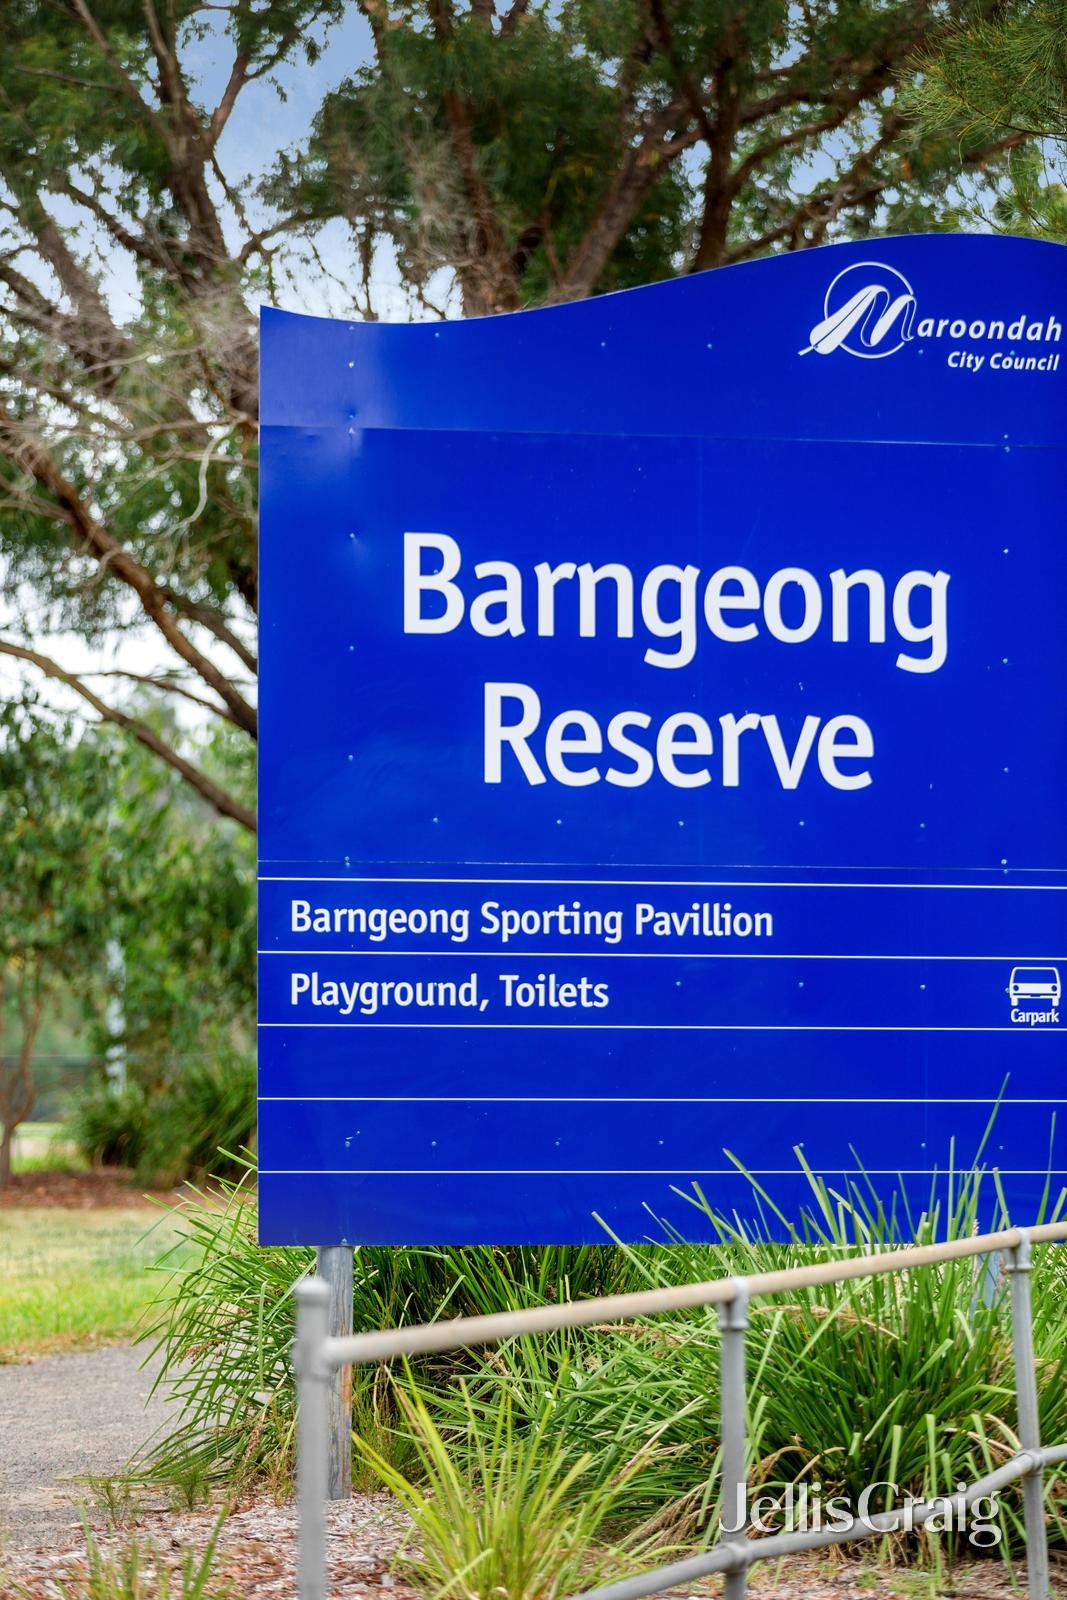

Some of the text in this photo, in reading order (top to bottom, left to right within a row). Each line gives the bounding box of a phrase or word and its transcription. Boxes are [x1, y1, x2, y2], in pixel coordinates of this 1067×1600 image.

[947, 351, 1060, 372] City Council
[403, 532, 951, 674] Barngeong
[484, 682, 875, 791] Reserve
[290, 899, 774, 944] Barngeong Sporting Pavillion
[290, 971, 610, 1015] Playground, Toilets
[1010, 1008, 1060, 1026] Carpark
